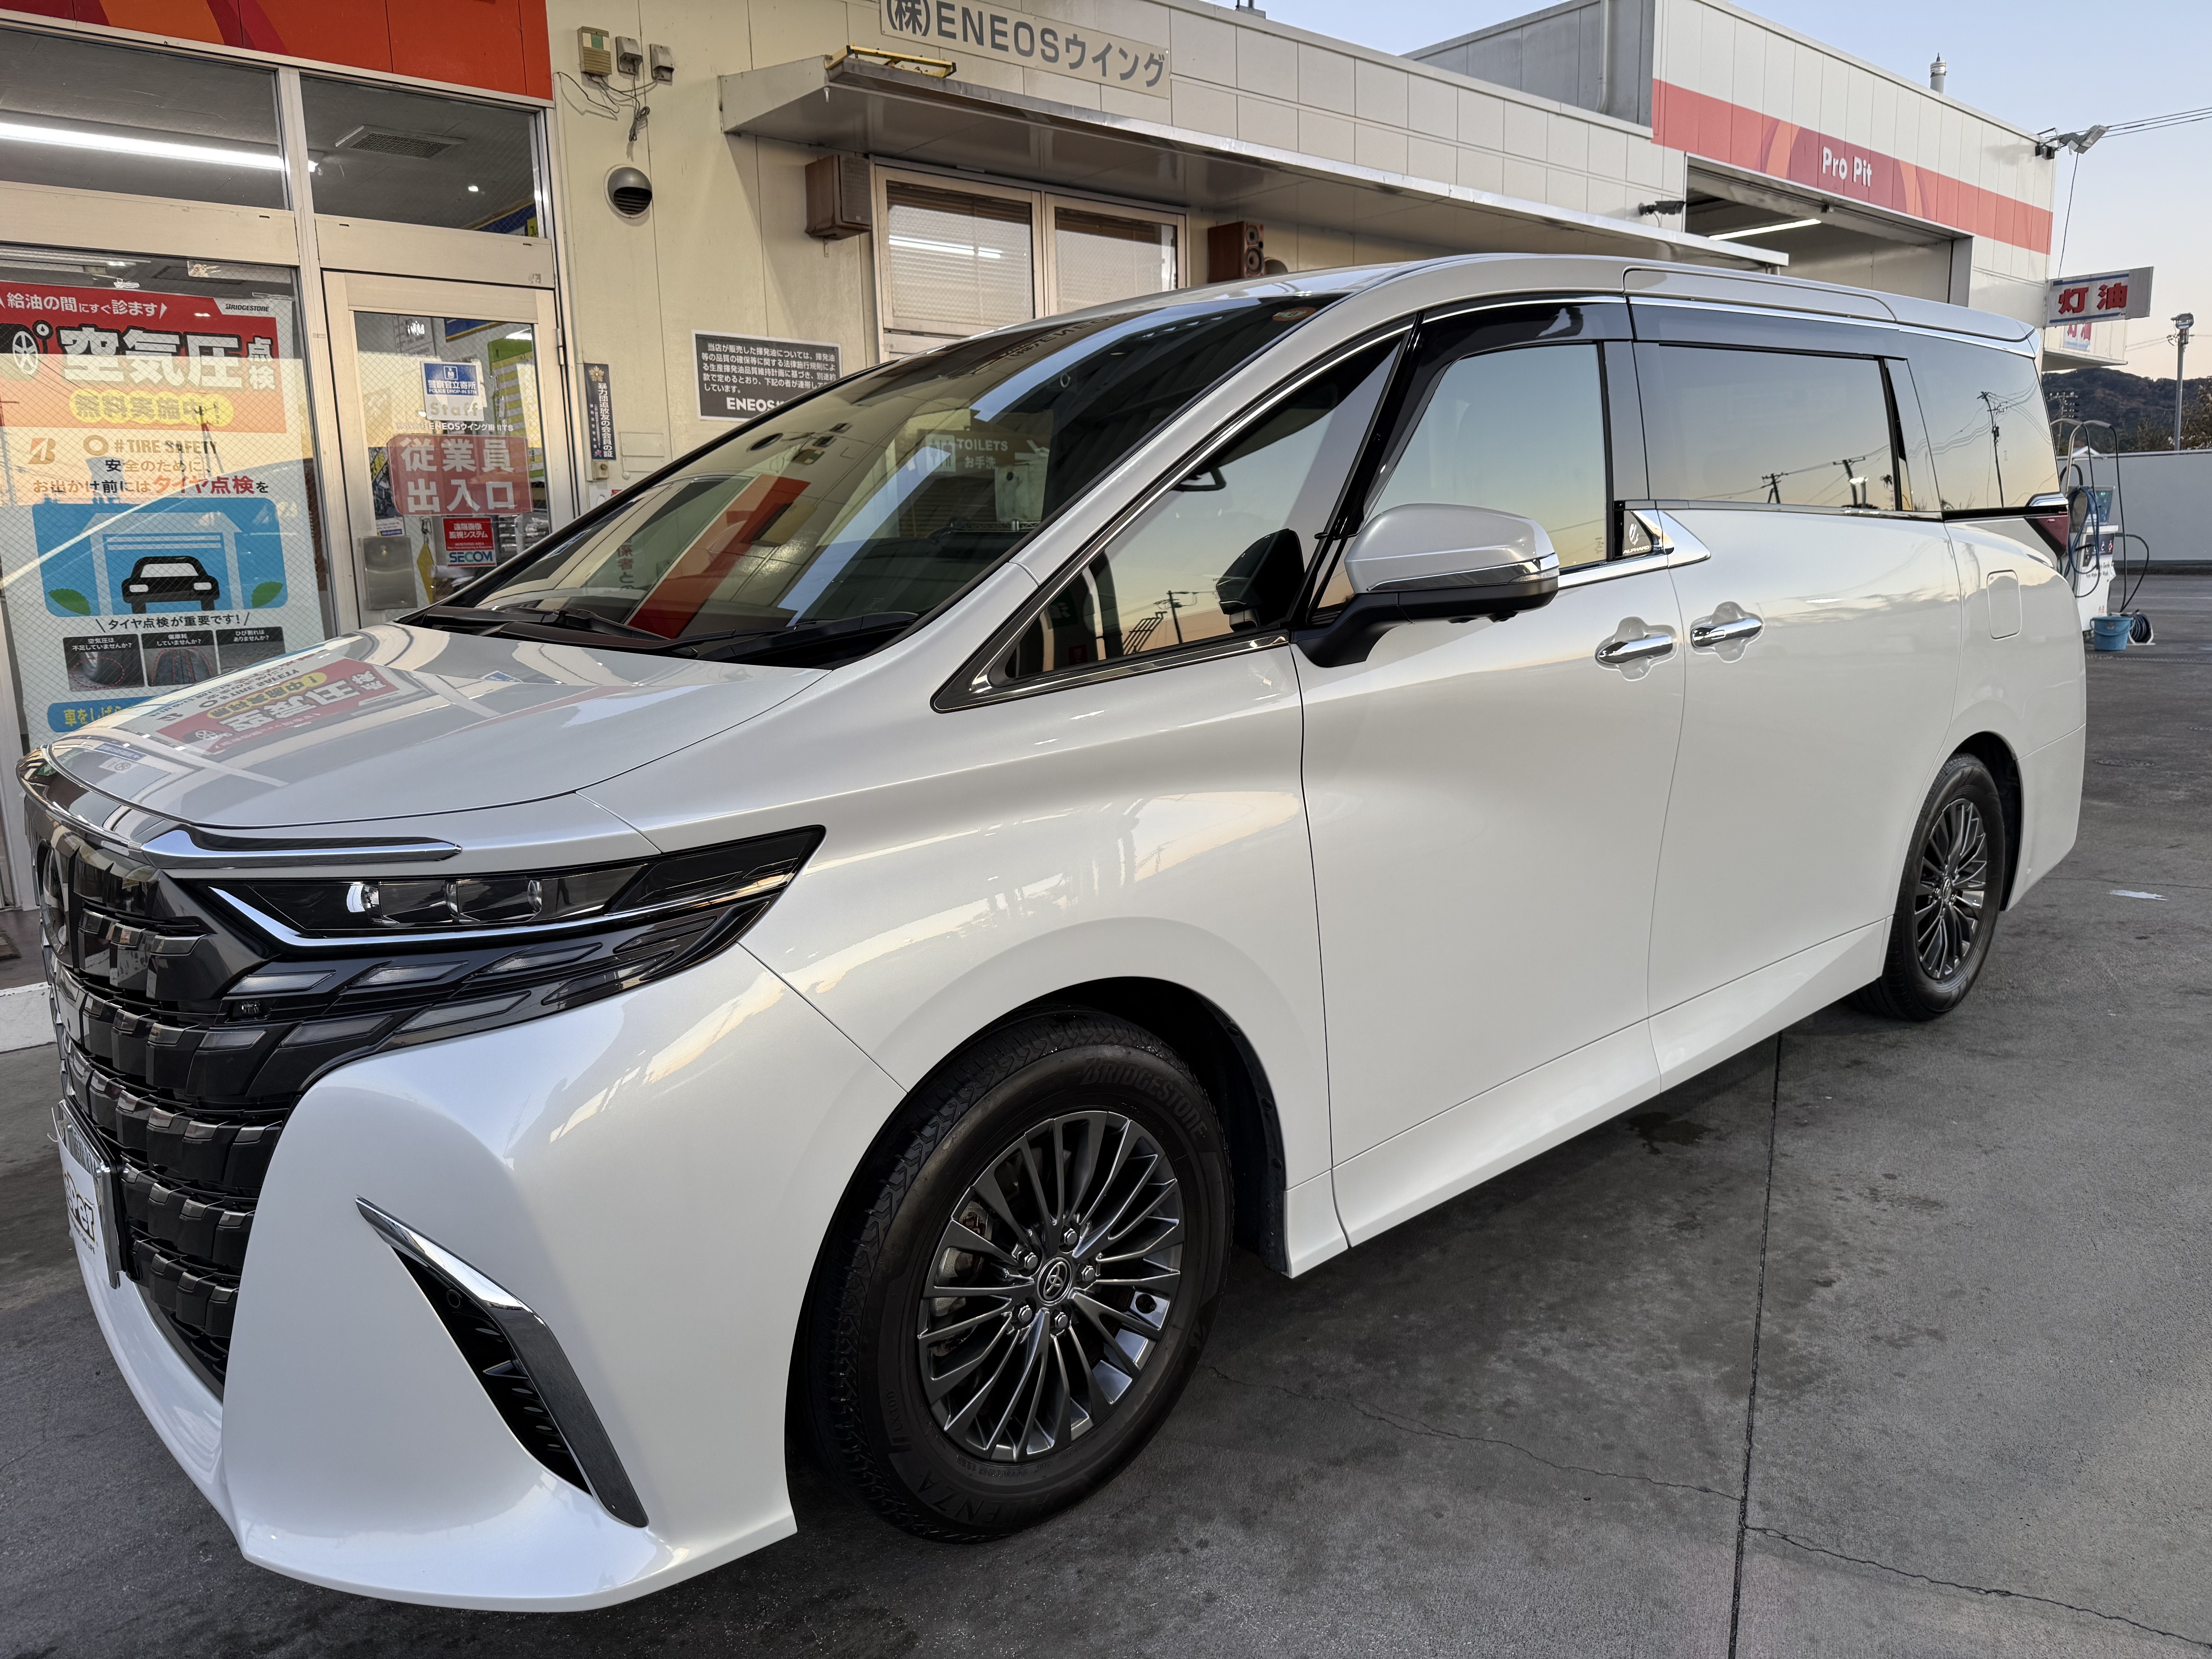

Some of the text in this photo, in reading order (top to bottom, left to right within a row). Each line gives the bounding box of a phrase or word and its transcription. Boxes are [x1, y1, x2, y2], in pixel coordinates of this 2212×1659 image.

[1822, 146, 1872, 187] Pro Pit
[7, 292, 158, 316] 給油の間にすぐ診ます
[225, 304, 270, 312] BRIDGESTONE
[2058, 283, 2128, 314] 灯油
[60, 327, 276, 390] 空気圧 点検
[701, 352, 836, 371] 等の品質の確保等に関する法律施行規則によ
[707, 343, 835, 362] 当店が販売した揮発油については、揮発油
[428, 380, 476, 390] 警察官立寄所
[704, 383, 741, 394] しています。
[430, 402, 478, 416] Staff
[598, 383, 613, 458] 暴力団追放友の会会員の証
[165, 440, 217, 454] SAFETY
[956, 438, 1008, 452] TOILETS
[400, 437, 515, 473] 従業員
[33, 475, 268, 495] お出かけ前にはタイヤ点検を
[407, 478, 515, 512] 出入口
[449, 551, 493, 563] SECOM
[108, 614, 240, 630] タイヤ点検が重要です!
[72, 643, 132, 651] 不足していませんか?
[1079, 1058, 1208, 1140] BRIDGESTONE
